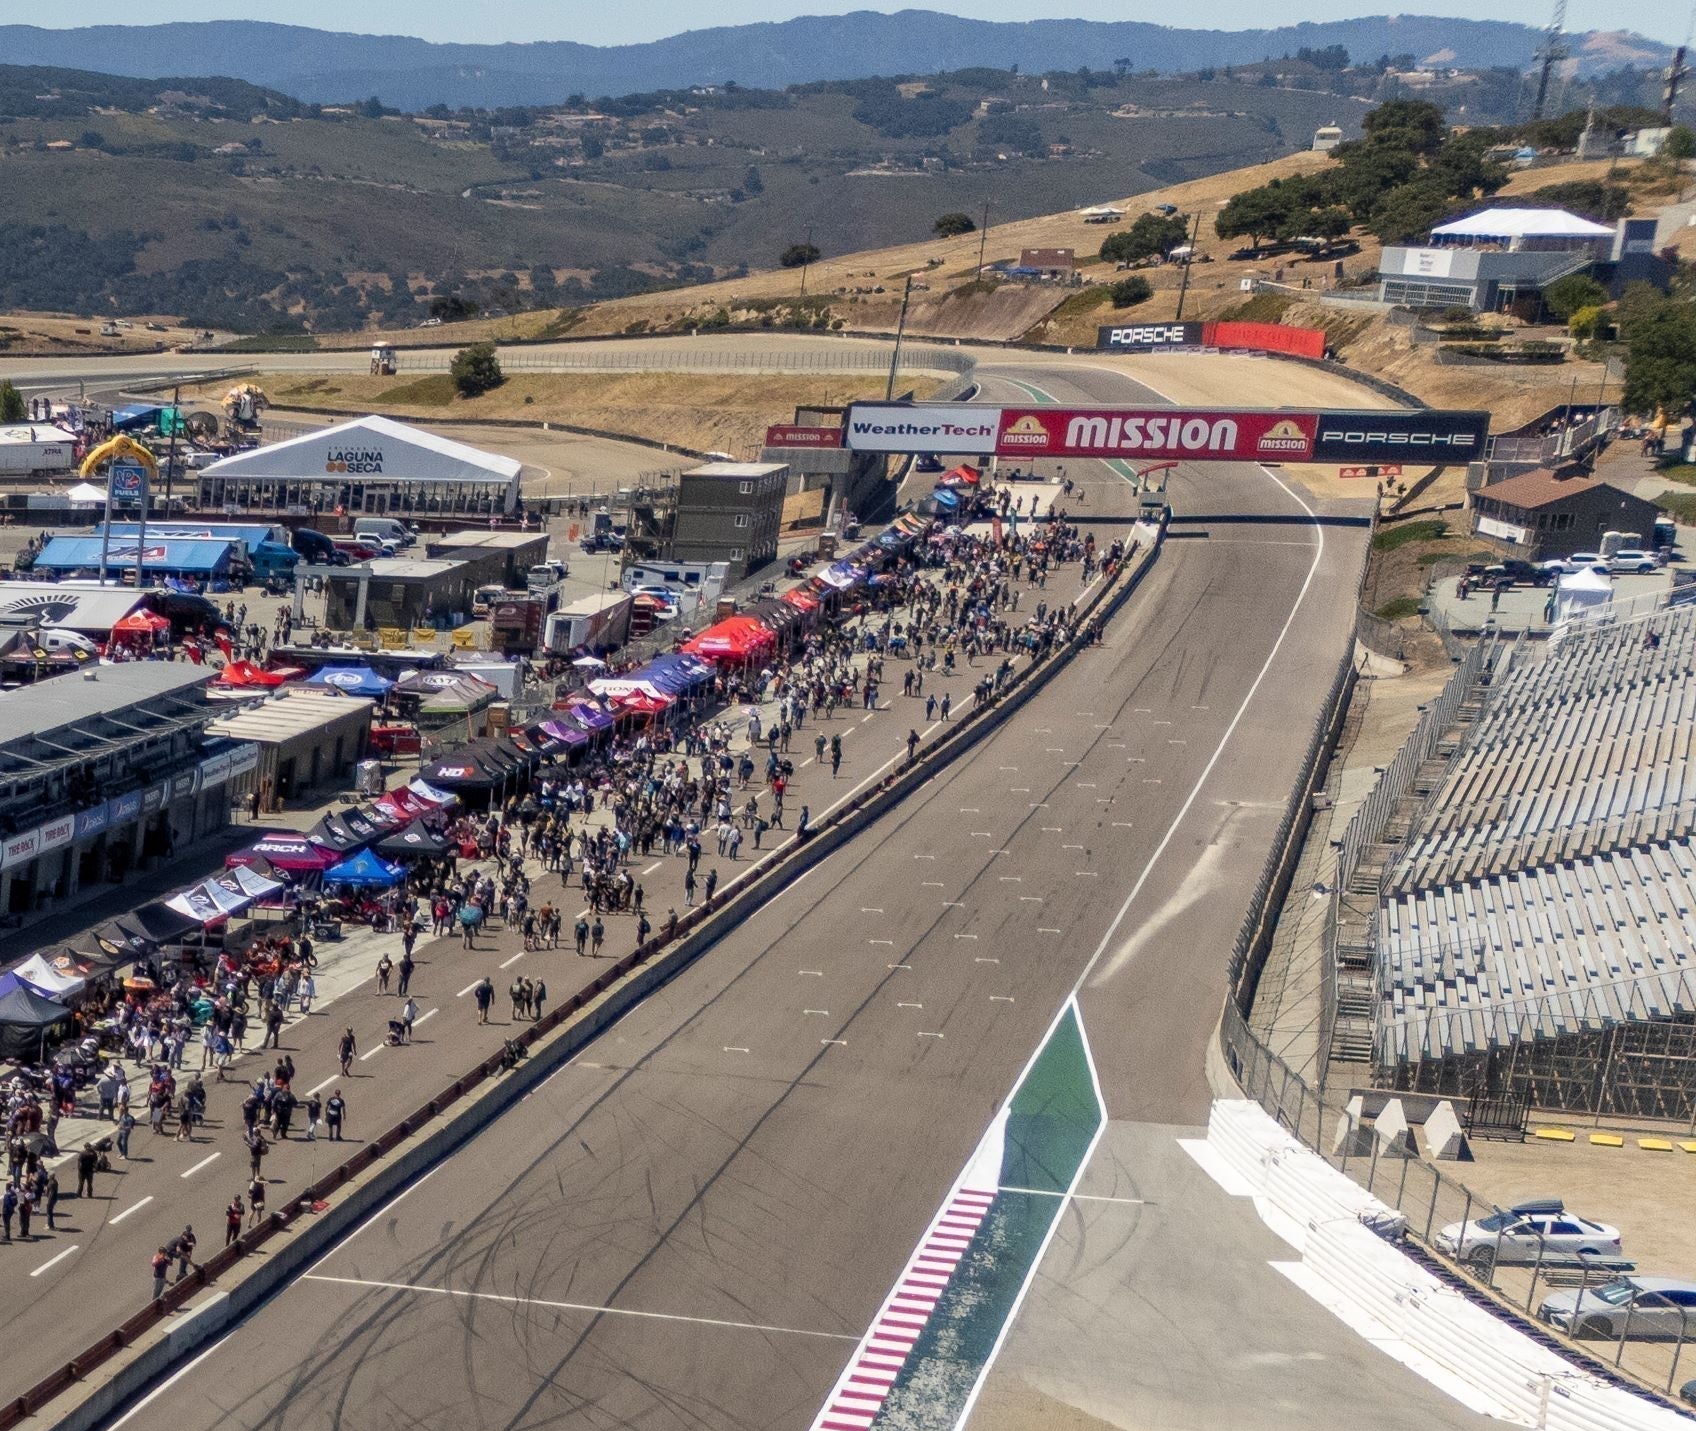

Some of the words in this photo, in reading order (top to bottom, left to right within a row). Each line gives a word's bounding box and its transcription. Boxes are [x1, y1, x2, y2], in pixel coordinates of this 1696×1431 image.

[1110, 326, 1185, 344] PORSCHE
[853, 422, 993, 437] WeatherTech
[1064, 416, 1239, 451] MISSION
[1322, 431, 1476, 446] PORSCHE
[327, 451, 384, 462] LAGUNA
[346, 462, 383, 473] SECA
[114, 489, 139, 497] FUELS
[252, 843, 307, 853] ARCH
